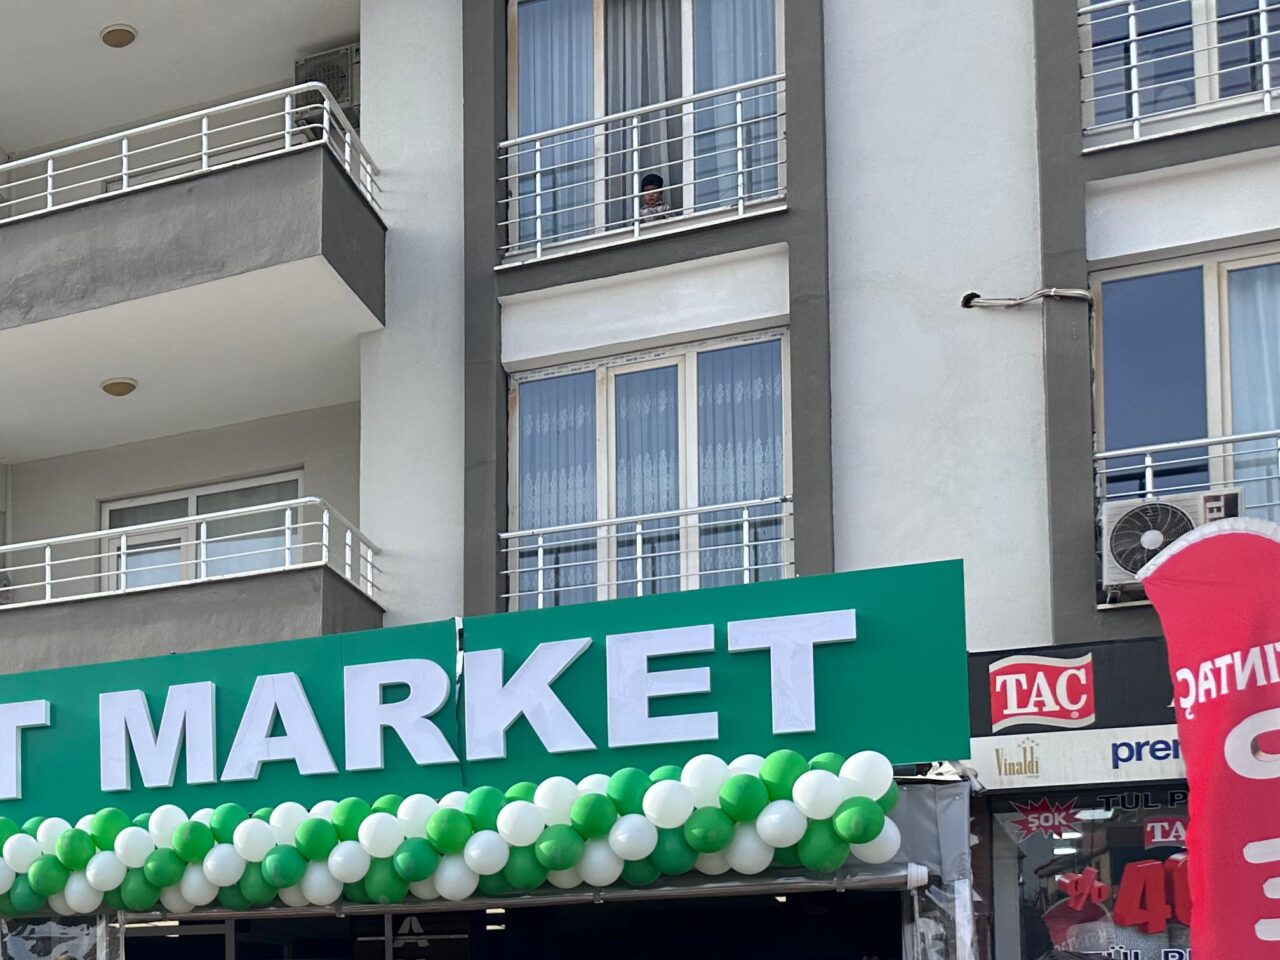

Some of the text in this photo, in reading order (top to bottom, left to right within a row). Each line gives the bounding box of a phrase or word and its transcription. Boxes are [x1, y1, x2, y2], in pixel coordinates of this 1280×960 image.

[99, 608, 858, 792] MARKET
[994, 745, 1040, 777] Vinaldi
[1028, 811, 1070, 831] ŞOK
